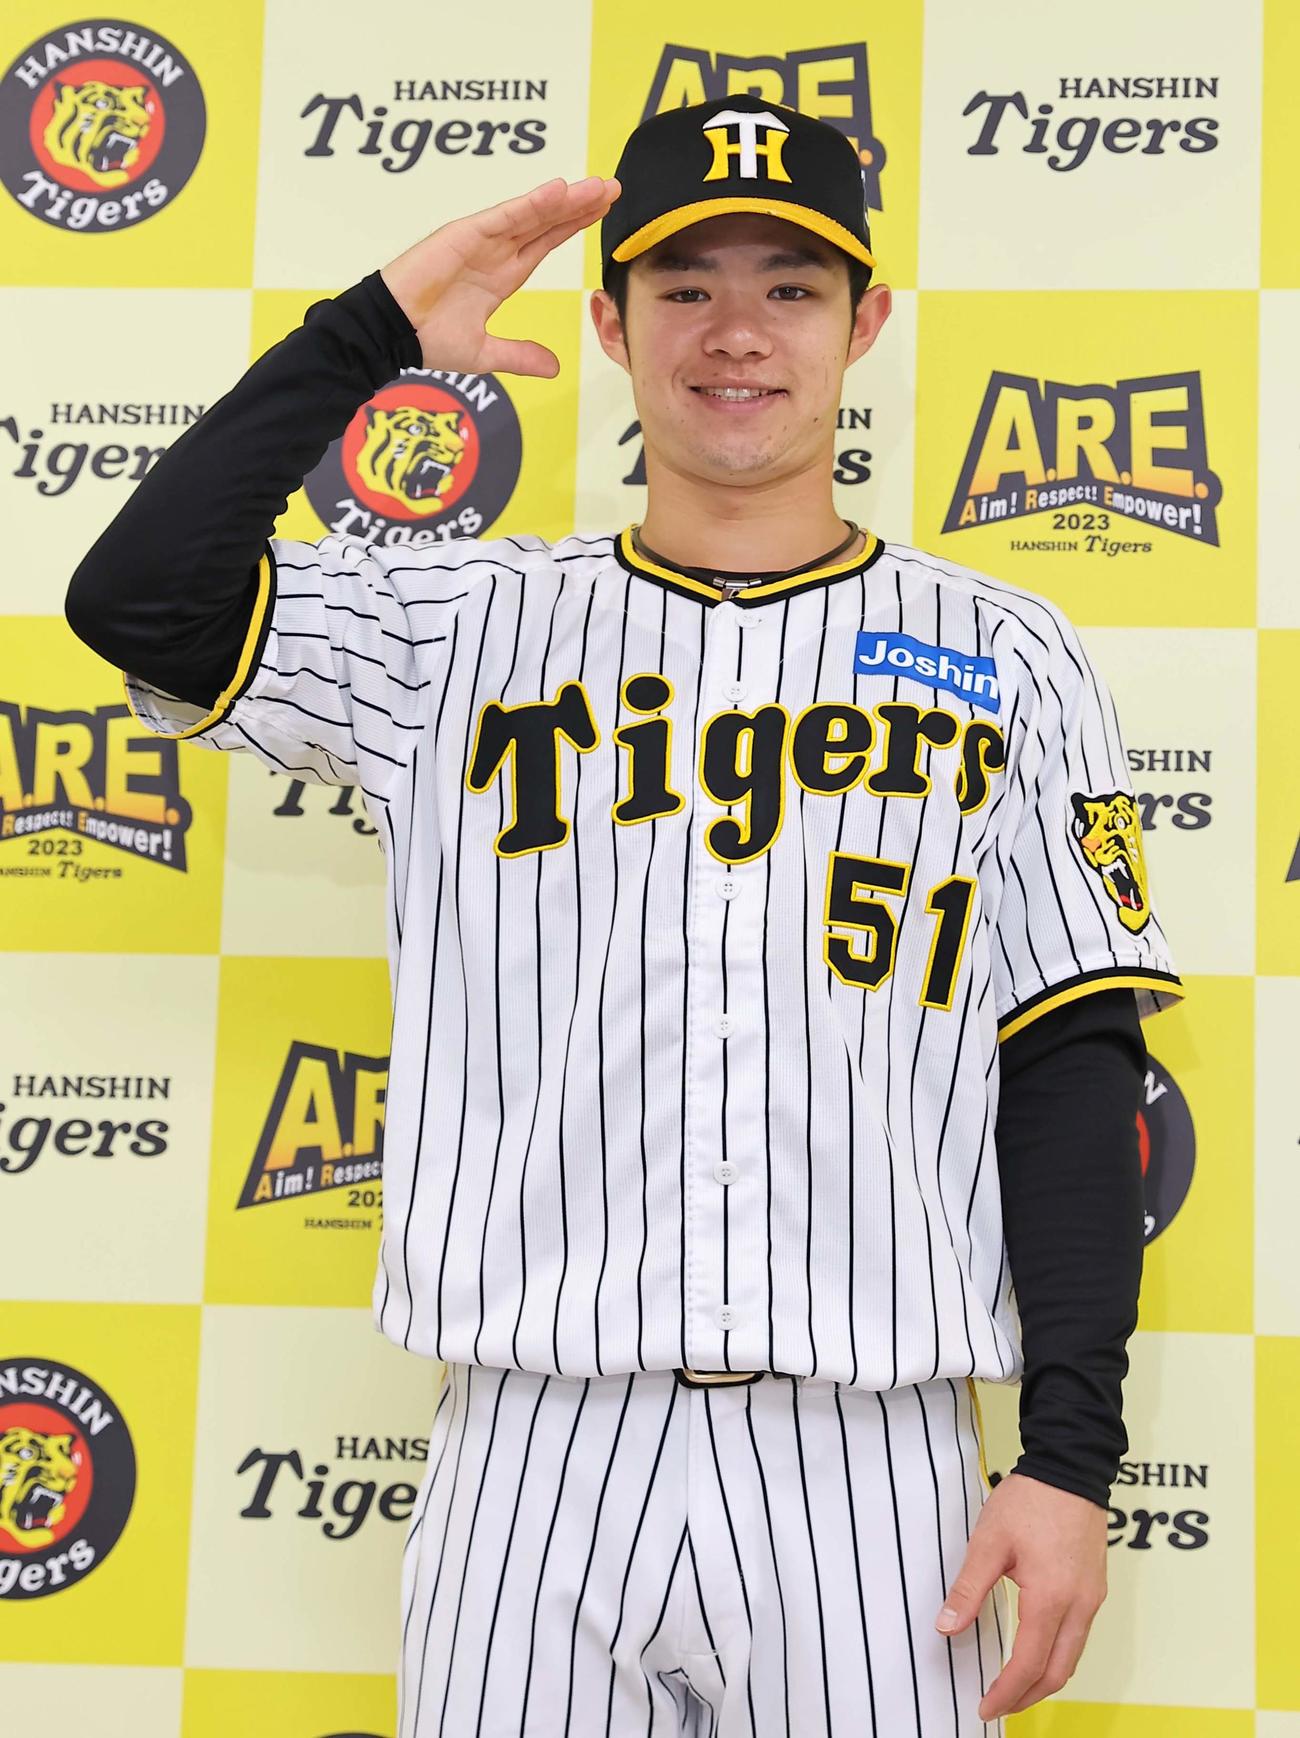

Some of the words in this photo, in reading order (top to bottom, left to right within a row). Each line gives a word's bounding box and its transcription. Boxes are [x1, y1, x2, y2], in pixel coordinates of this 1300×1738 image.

[15, 27, 184, 89] HANSHIN
[394, 80, 548, 101] HANSHIN
[1058, 77, 1219, 99] HANSHIN
[300, 93, 547, 173] Tigers
[963, 90, 1219, 172] Tigers
[17, 170, 169, 229] Tigers
[51, 404, 205, 425] HANSHIN
[0, 416, 167, 496] iger
[968, 386, 1209, 499] A.R.E.
[959, 492, 1018, 526] Aim!
[1025, 485, 1098, 511] Respect!
[1104, 486, 1202, 535] Empower!
[1053, 514, 1111, 530] 2023
[1010, 540, 1078, 551] HANSHIN
[1084, 535, 1153, 556] Tigers
[858, 640, 999, 700] Joshin
[465, 672, 1006, 865] Tigers
[1127, 750, 1213, 773] SHIN
[2, 810, 74, 837] Respect!
[78, 811, 173, 862] Empower!
[28, 839, 83, 856] 2023
[0, 867, 52, 877] ANSHIN
[57, 861, 123, 882] Tigers
[823, 851, 978, 1012] 51
[14, 1075, 171, 1099] HANSHIN
[0, 1102, 169, 1174] gers
[253, 1166, 315, 1201] Aim!
[320, 1161, 383, 1187] Respec
[304, 1218, 372, 1230] HANSHIN
[0, 1366, 114, 1436] NSHIN
[336, 1436, 430, 1461] HANS
[236, 1447, 418, 1540] Tige
[1117, 1462, 1208, 1488] SHIN
[0, 1538, 95, 1595] gers
